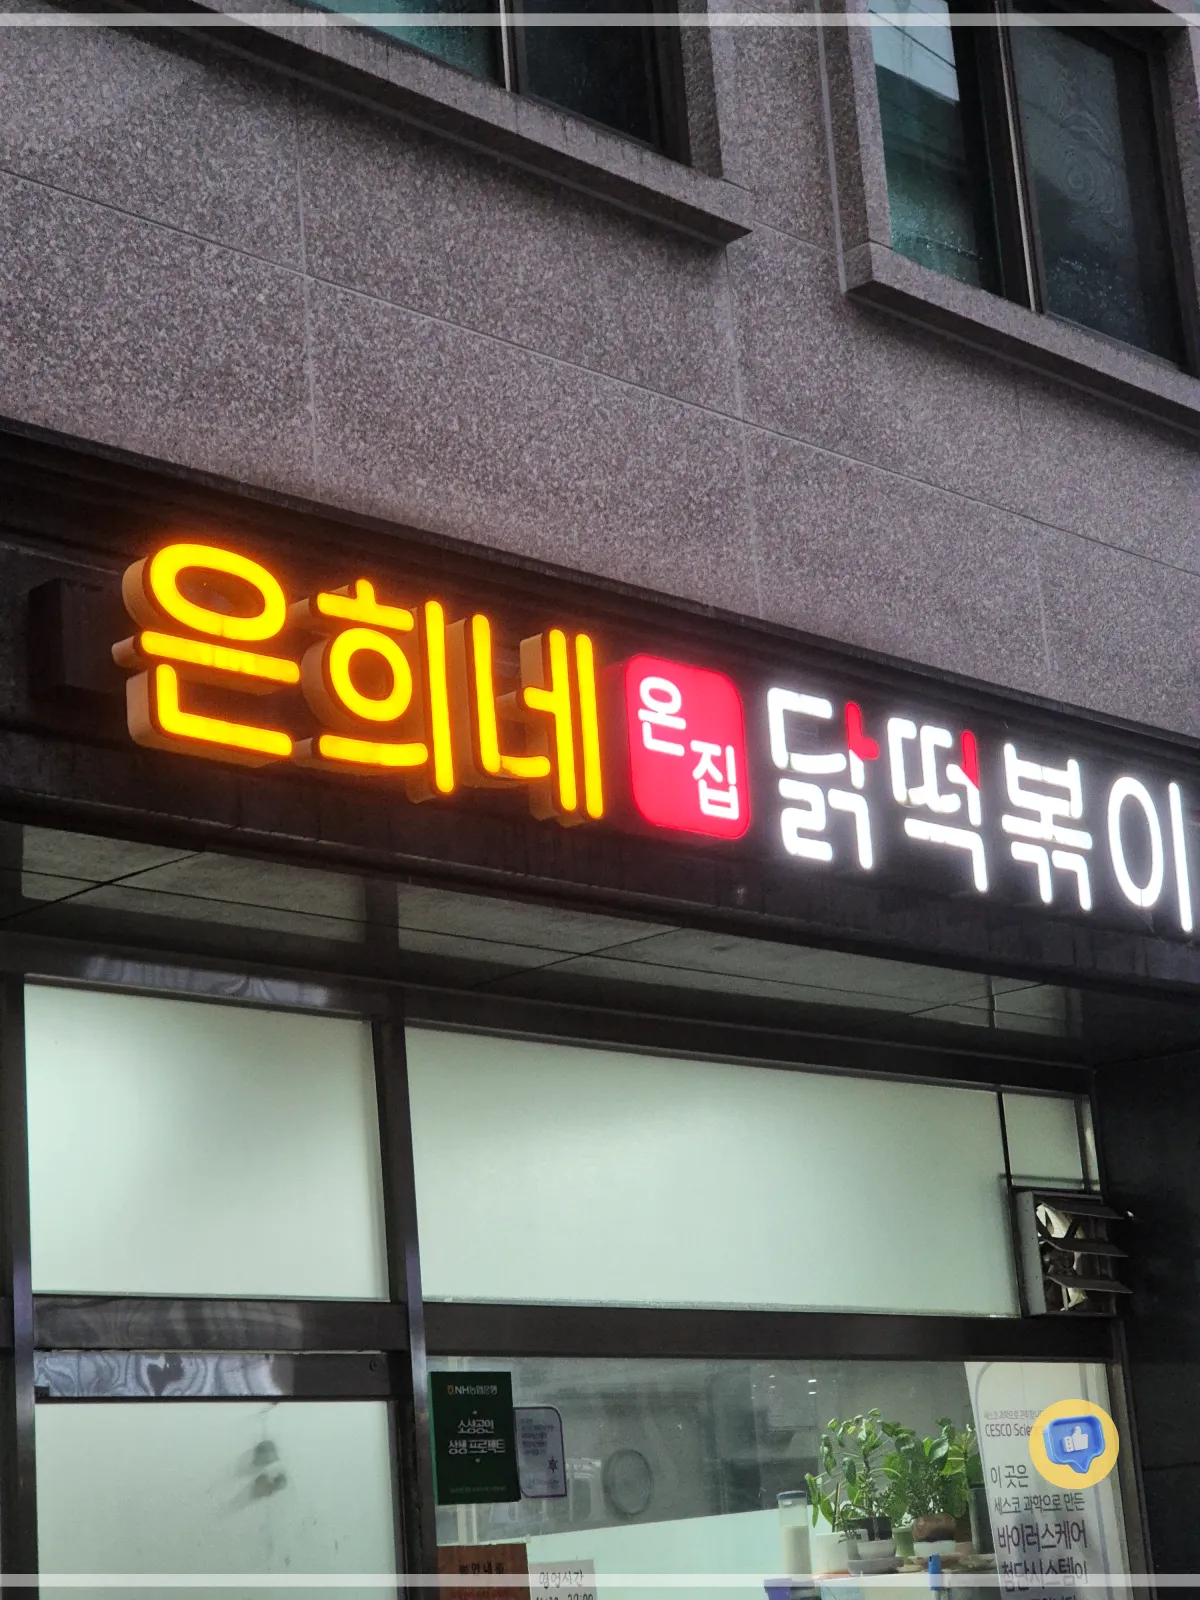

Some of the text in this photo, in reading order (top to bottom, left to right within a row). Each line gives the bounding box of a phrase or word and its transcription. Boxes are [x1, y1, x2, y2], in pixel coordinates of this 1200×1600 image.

[138, 542, 605, 821] 은희네
[766, 685, 1195, 934] 닭떡볶이
[458, 1418, 494, 1434] 소상공인
[985, 1423, 1033, 1437] CESCO Scie
[448, 1438, 506, 1455] 상생 프로젝트
[990, 1464, 1029, 1489] 이 곳은
[993, 1492, 1085, 1515] 세스코 과학으로 만든
[997, 1519, 1088, 1554] 바이러스케어
